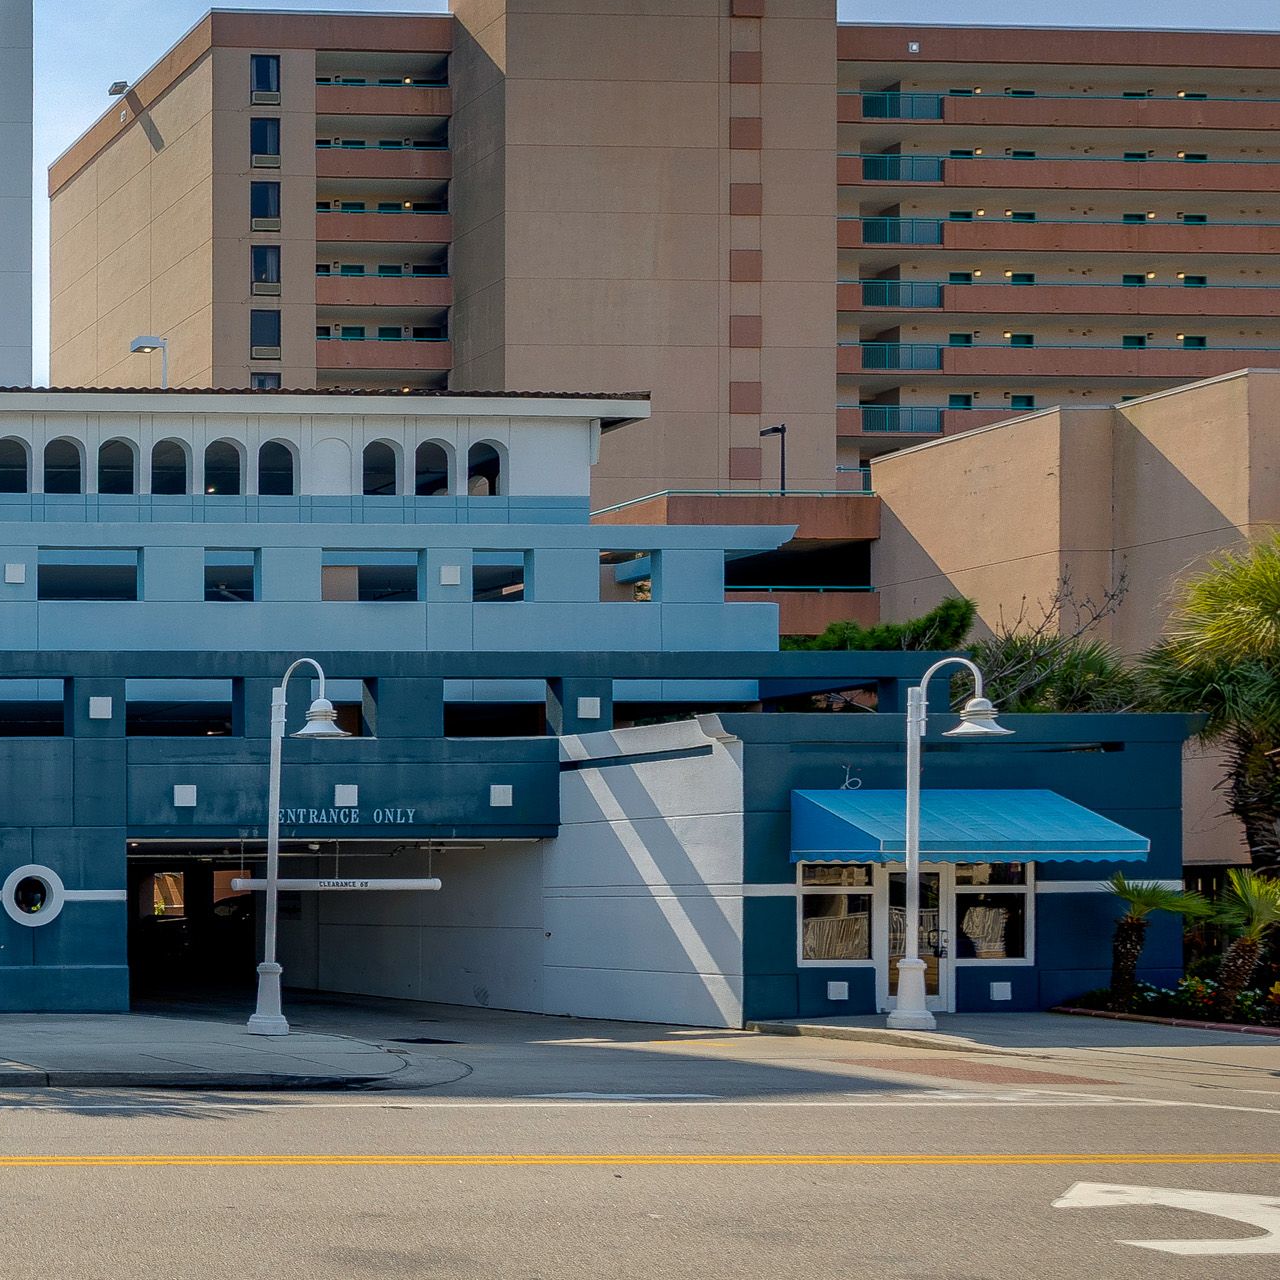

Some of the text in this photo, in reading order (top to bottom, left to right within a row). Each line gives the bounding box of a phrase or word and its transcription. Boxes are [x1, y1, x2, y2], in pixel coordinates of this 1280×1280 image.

[278, 808, 416, 824] ENTRANCE ONLY
[318, 880, 357, 888] CLEARANCE
